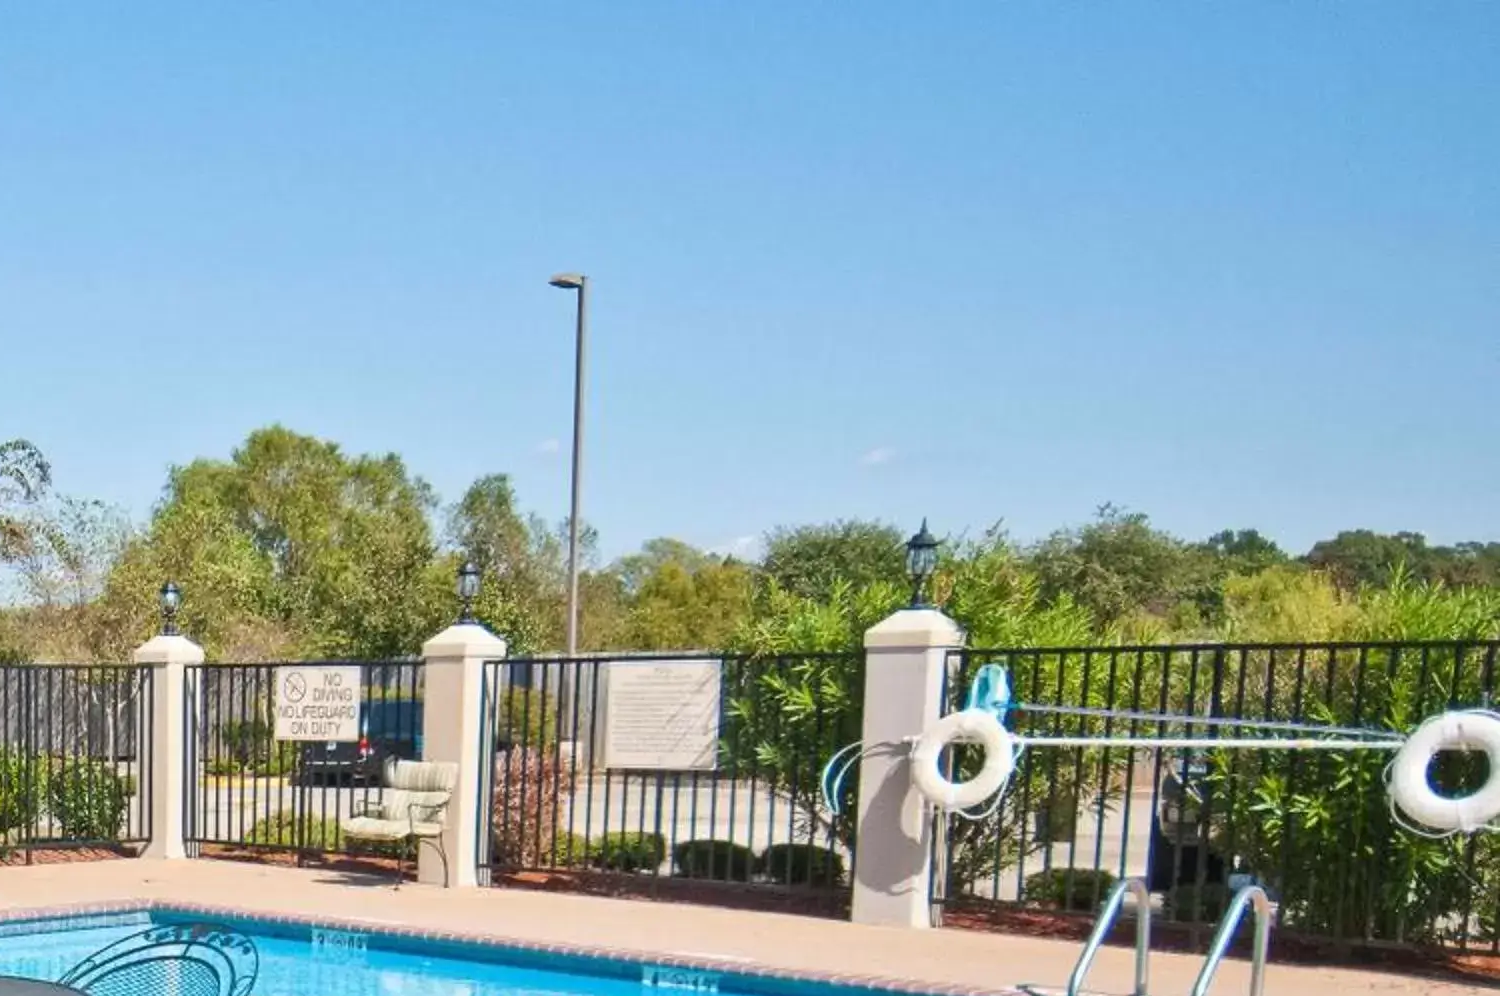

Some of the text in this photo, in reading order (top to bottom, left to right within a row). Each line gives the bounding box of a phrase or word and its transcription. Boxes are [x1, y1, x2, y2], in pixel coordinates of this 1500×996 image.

[323, 672, 343, 687] NO
[312, 687, 354, 702] DIVING
[279, 705, 357, 720] NO LIFEGUARD
[290, 721, 342, 735] ON DUTY
